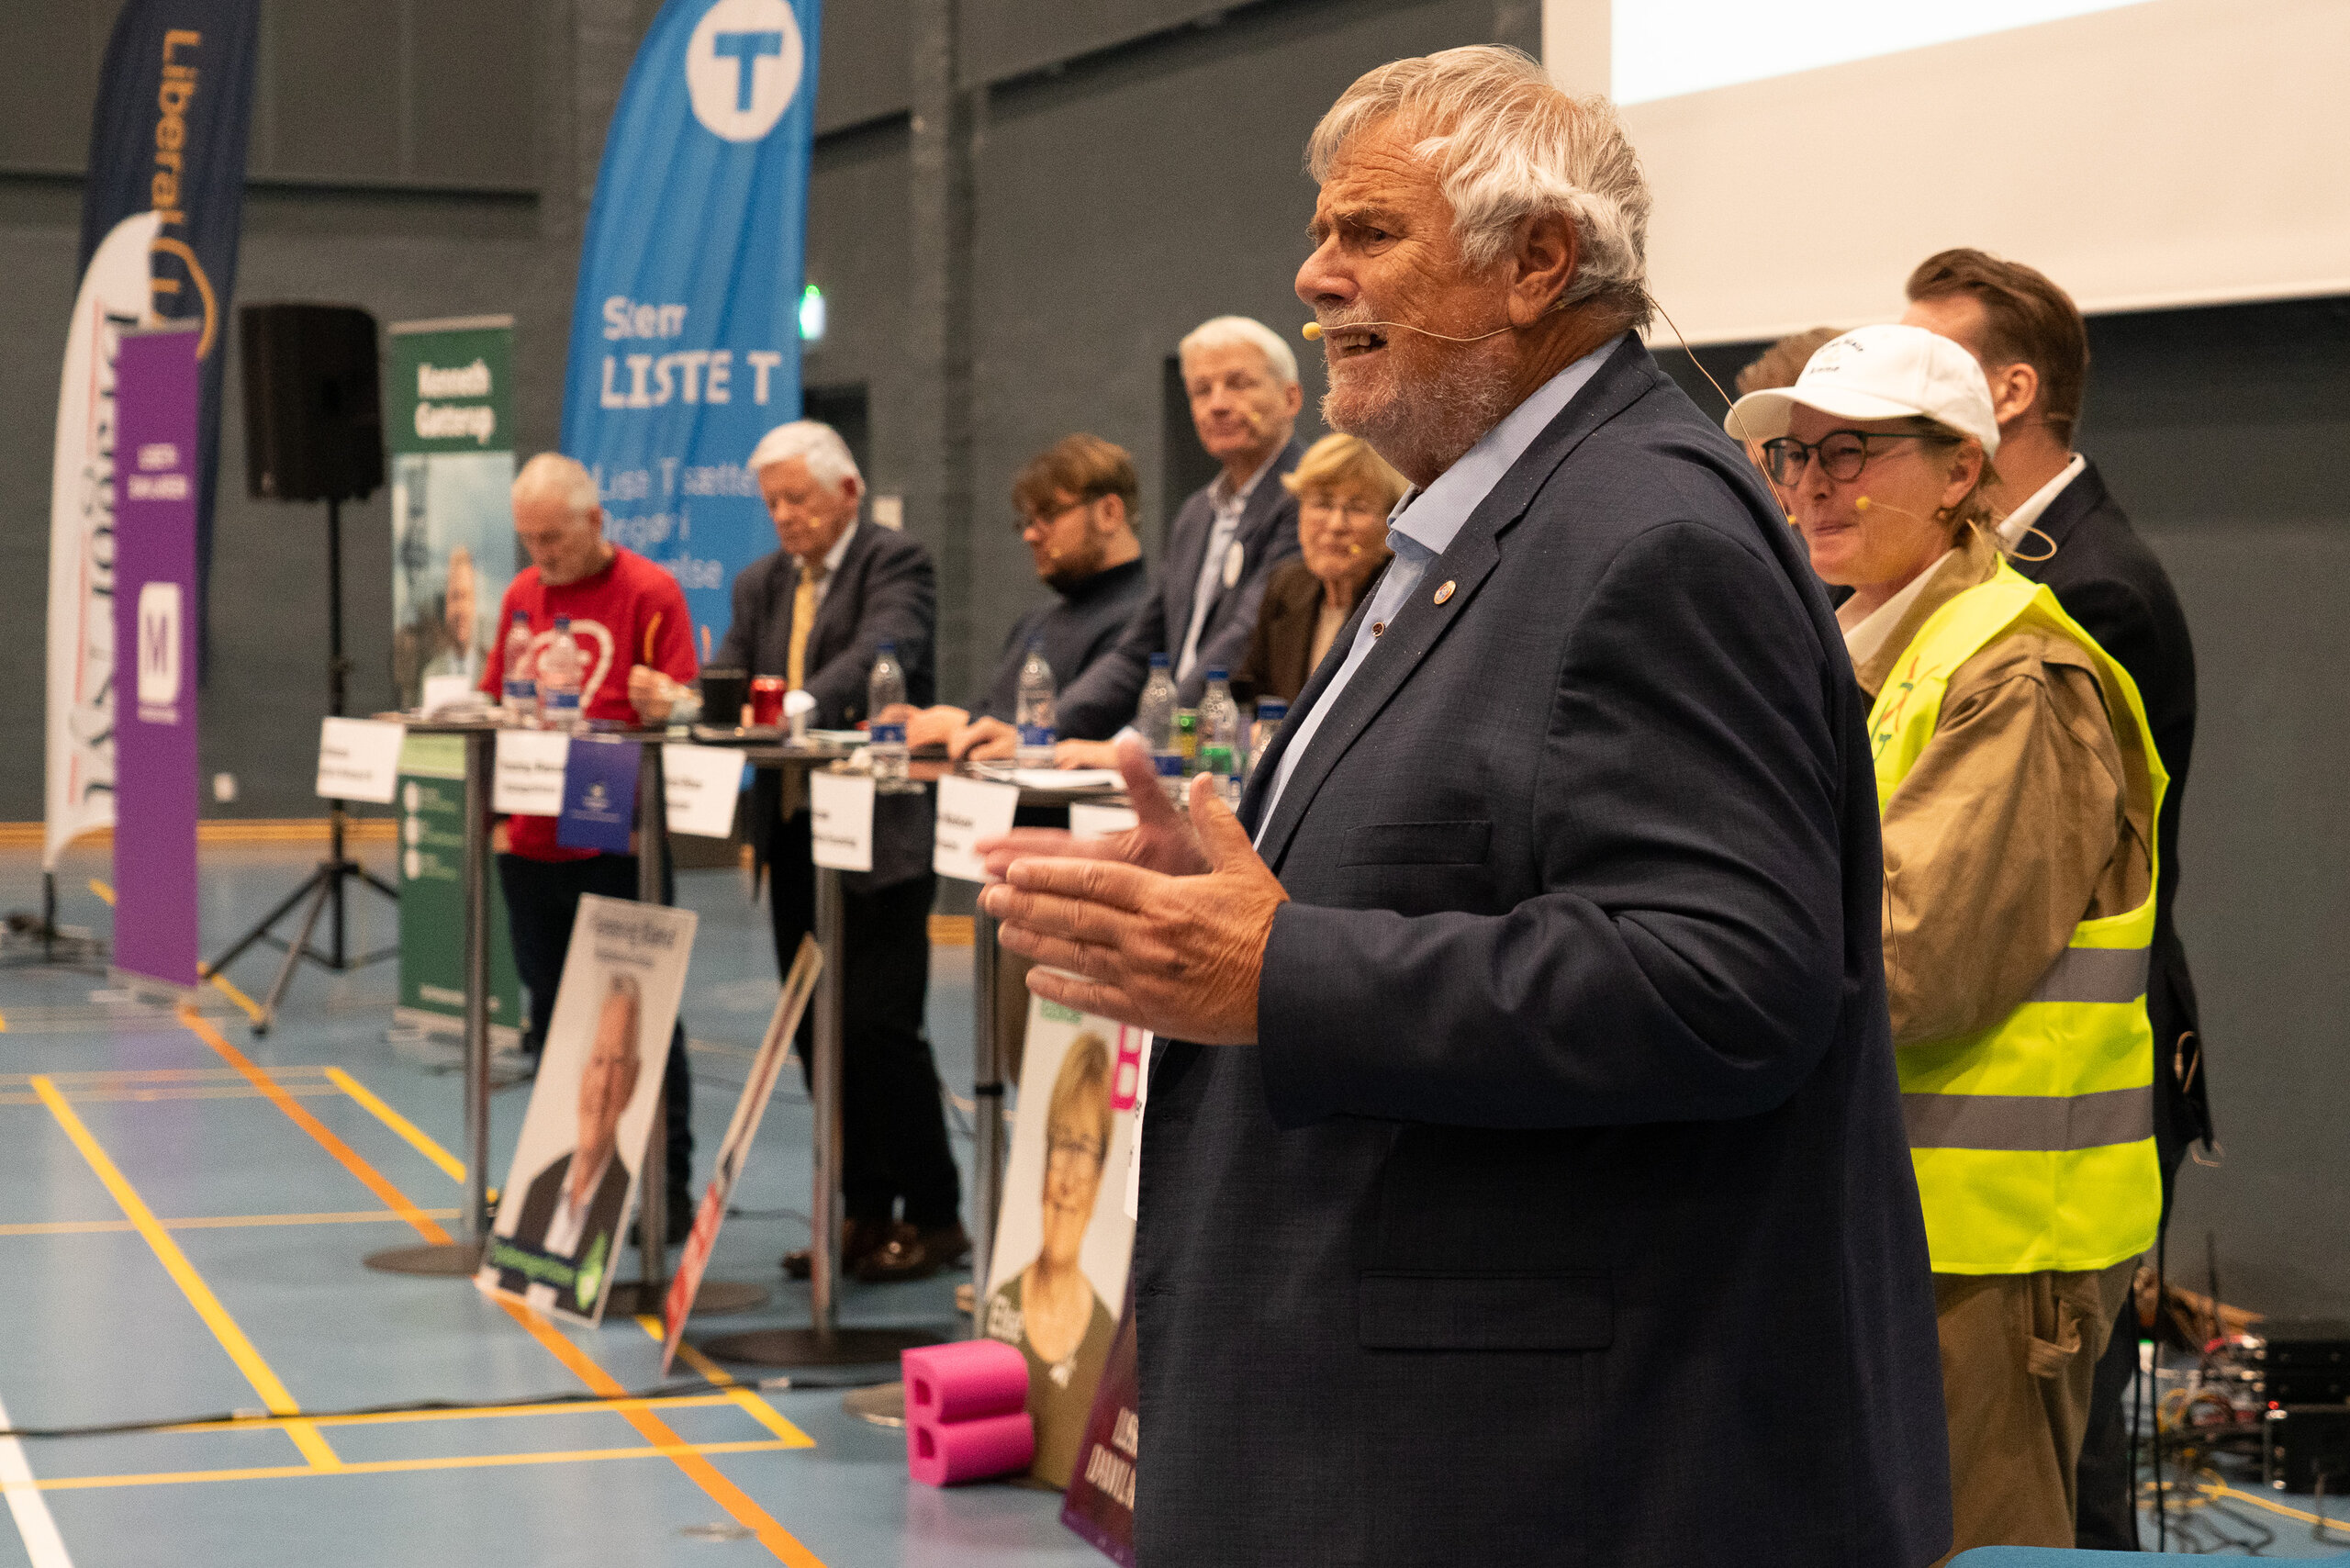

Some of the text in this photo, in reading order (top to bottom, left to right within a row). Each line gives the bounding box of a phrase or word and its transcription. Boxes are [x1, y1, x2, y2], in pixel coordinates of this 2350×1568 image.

[713, 30, 783, 112] T
[149, 28, 201, 224] Liberal
[600, 350, 782, 409] LISTE T
